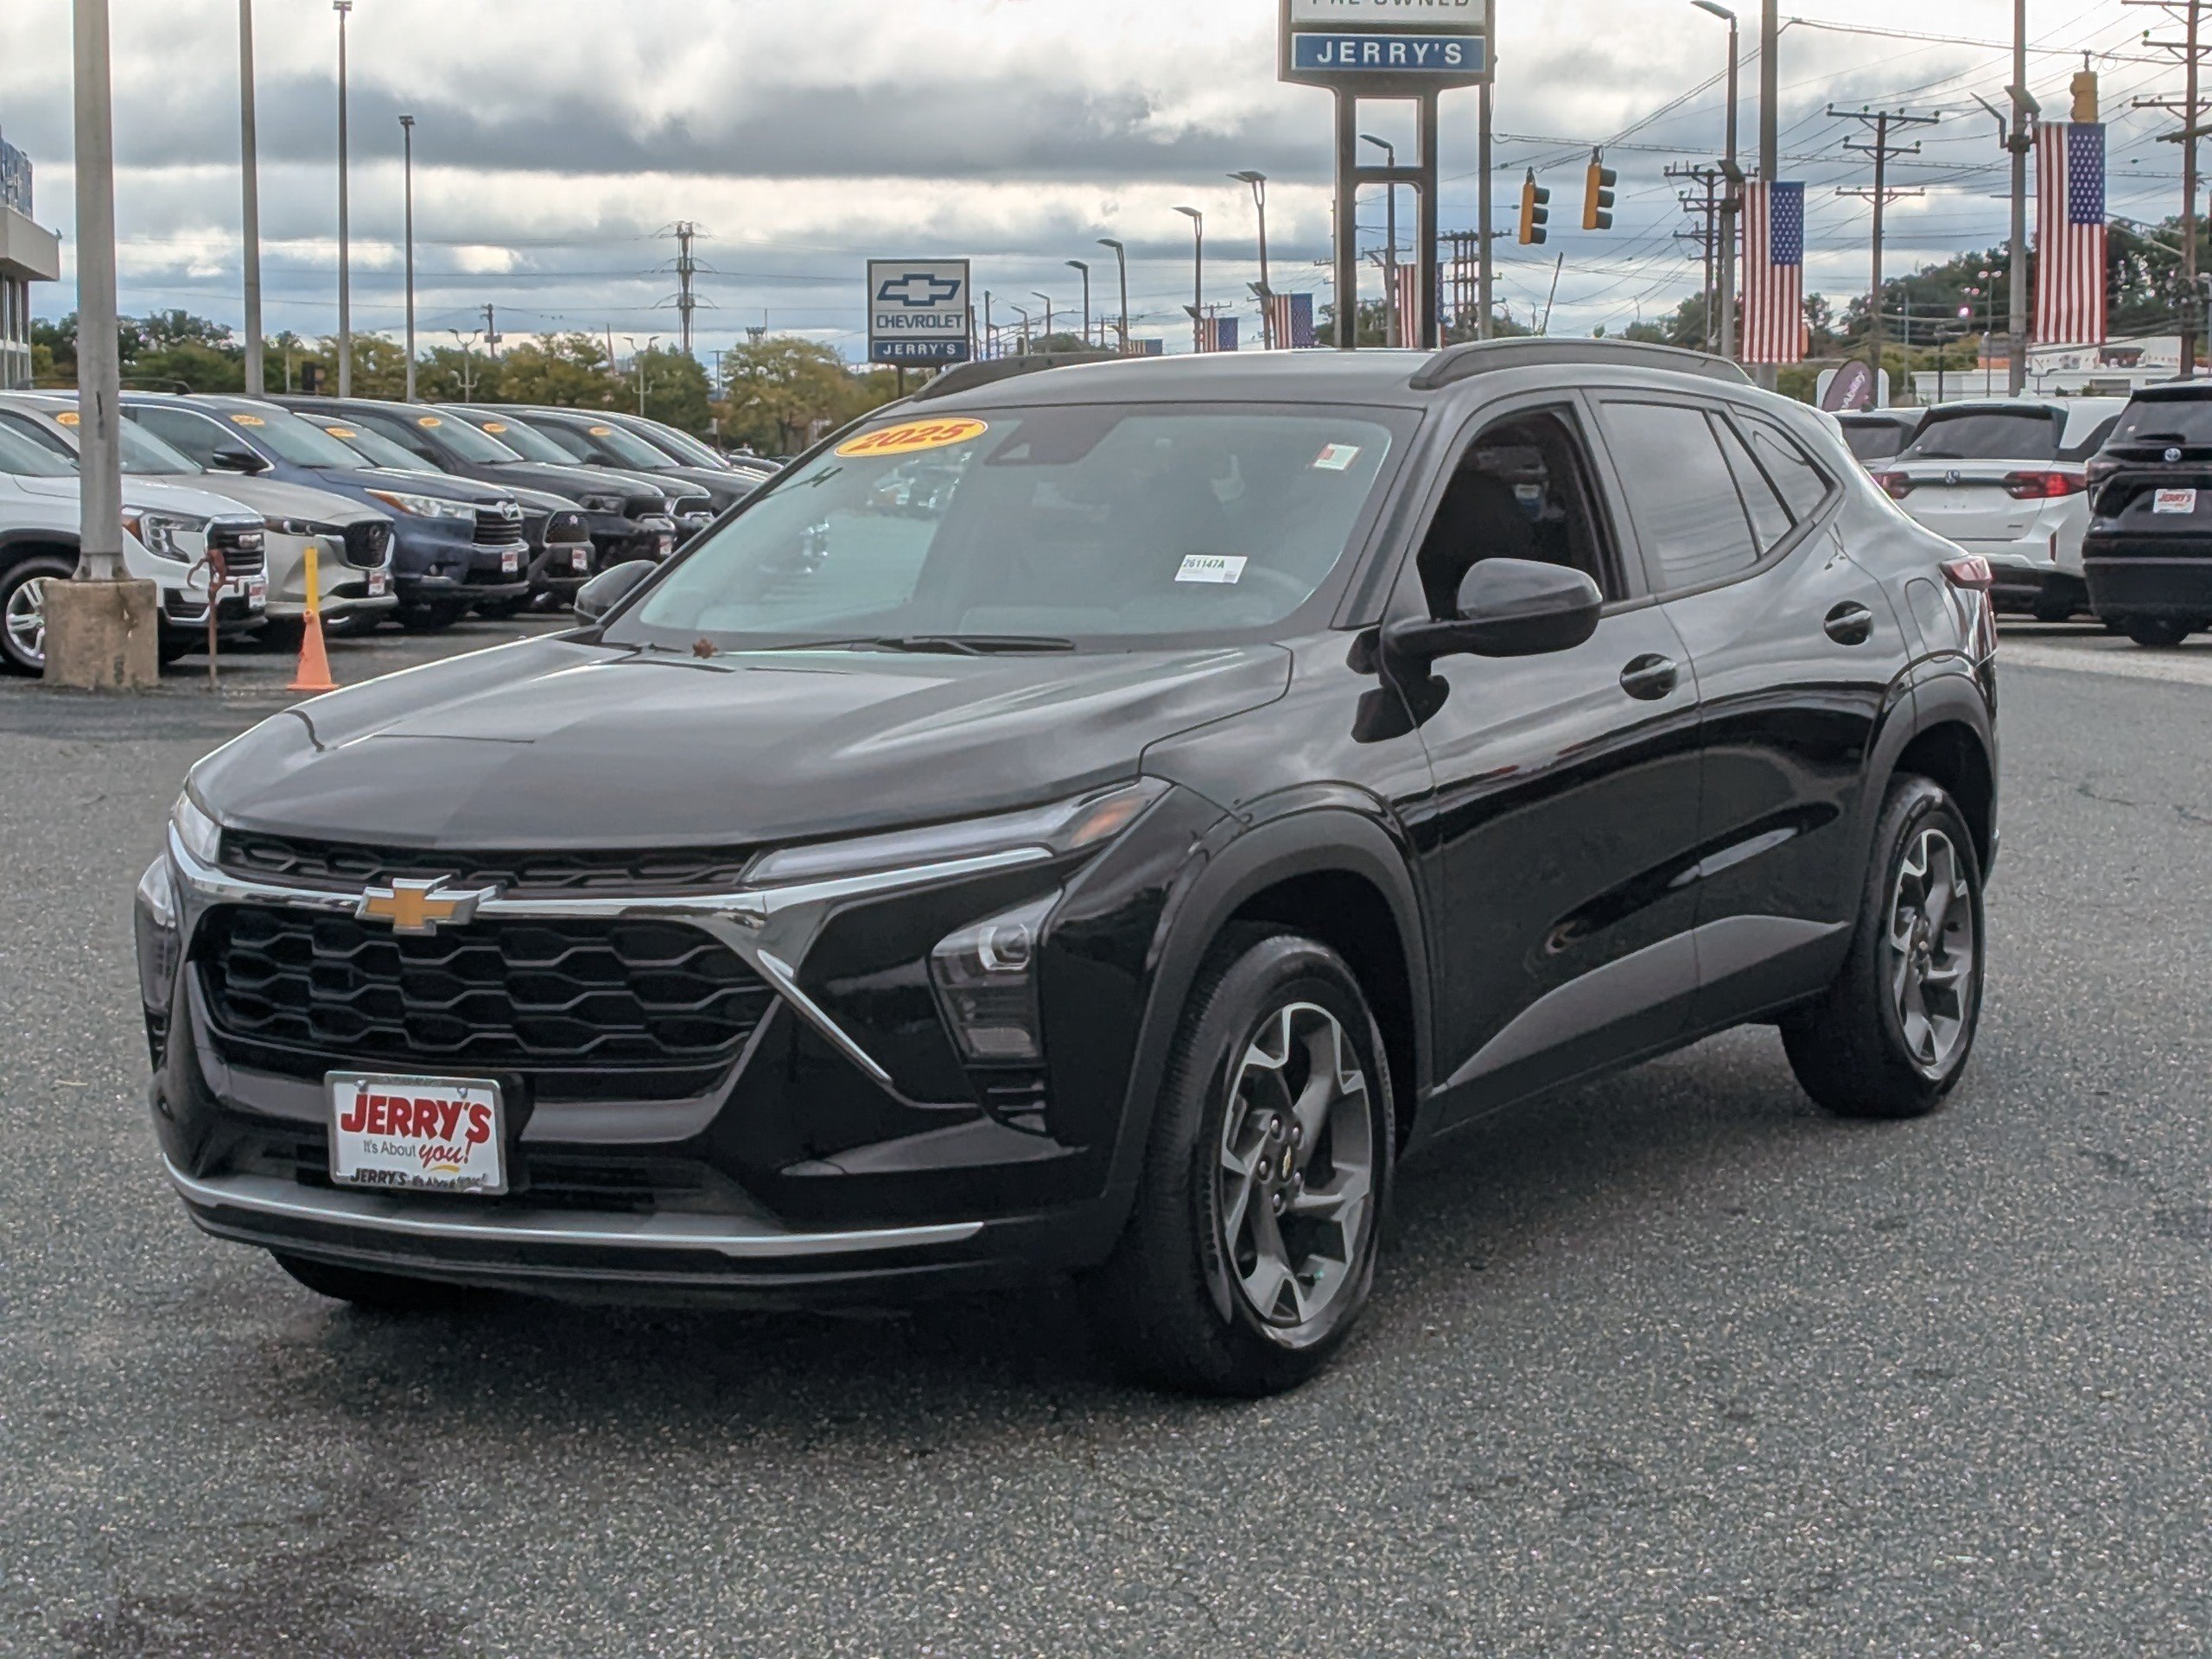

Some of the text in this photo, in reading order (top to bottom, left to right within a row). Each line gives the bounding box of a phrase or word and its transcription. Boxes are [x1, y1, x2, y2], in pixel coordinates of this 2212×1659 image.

[1317, 41, 1462, 65] JERRY'S
[876, 315, 963, 328] CHEVROLET
[883, 343, 956, 355] JERRY'S
[846, 422, 976, 452] 2025
[340, 1094, 492, 1143] JERRY'S
[363, 1140, 473, 1168] It's About you!
